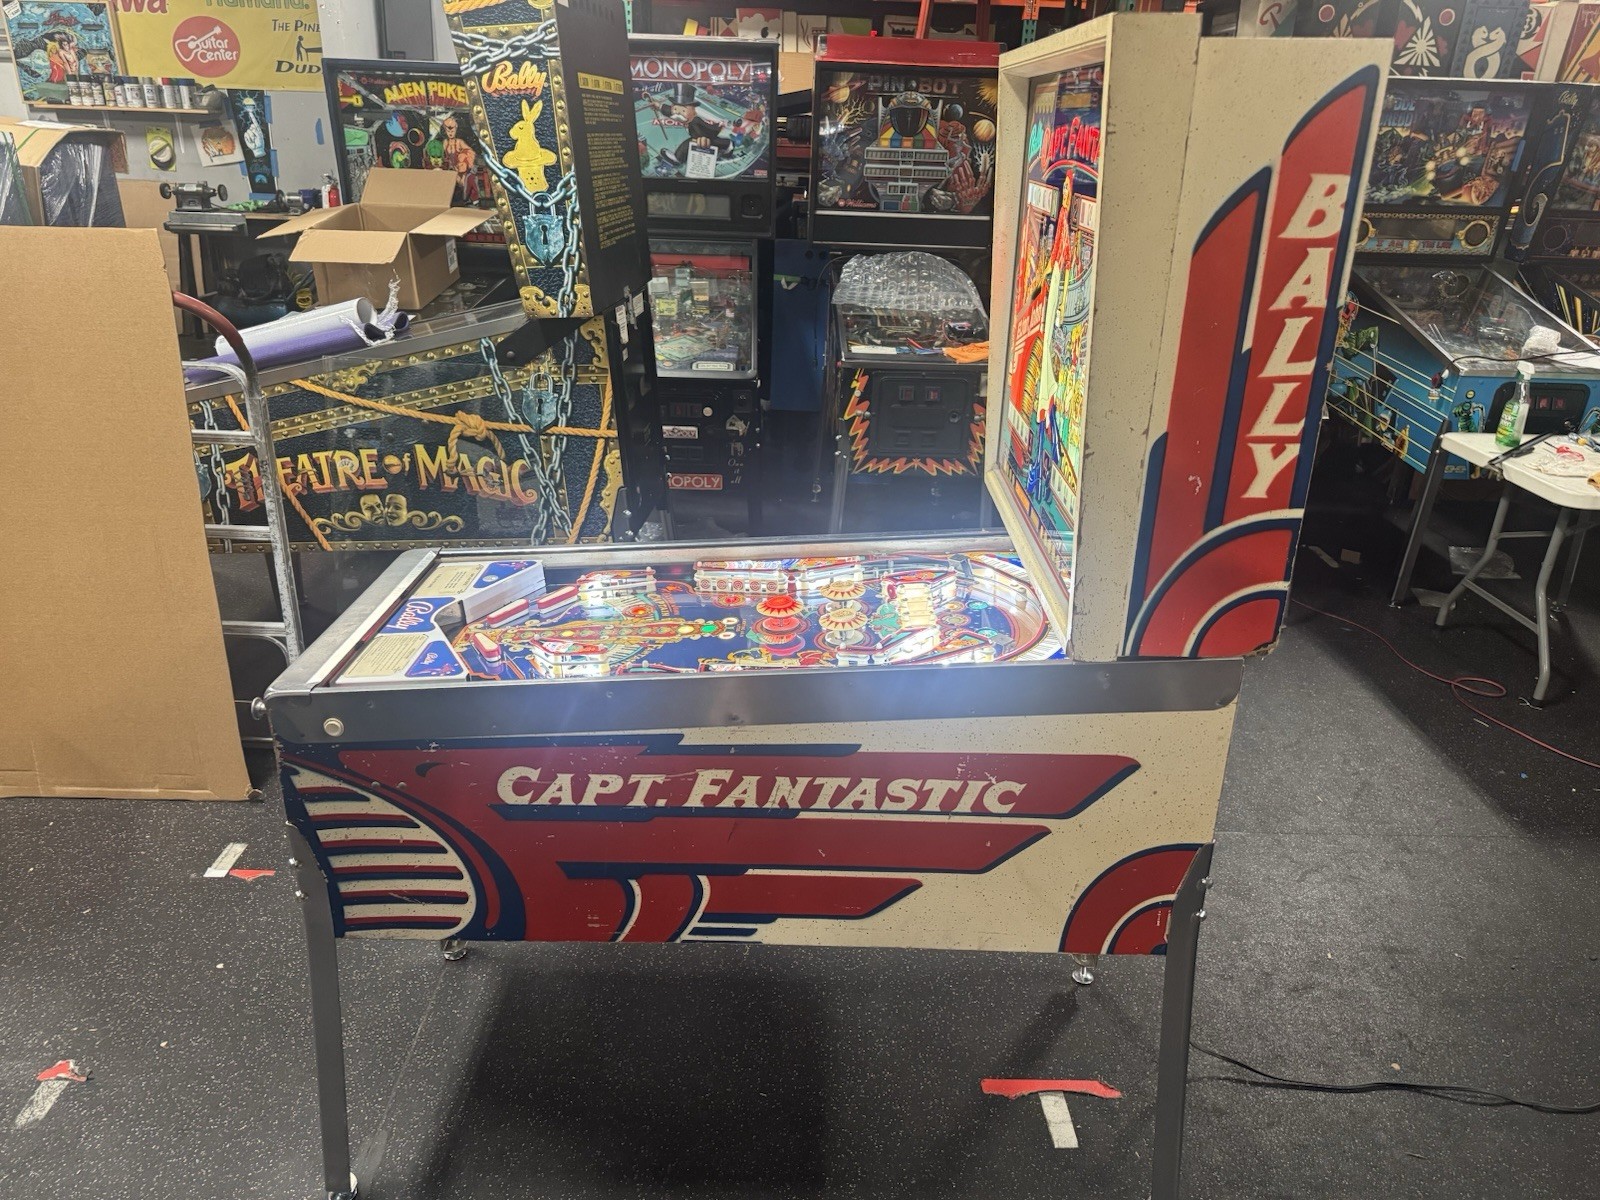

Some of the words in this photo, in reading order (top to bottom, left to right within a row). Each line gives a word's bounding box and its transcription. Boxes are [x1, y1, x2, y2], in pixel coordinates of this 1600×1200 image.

[198, 49, 237, 63] Center
[275, 60, 323, 74] DUD
[384, 81, 426, 104] ALIEN
[482, 61, 547, 98] Bally
[1240, 173, 1351, 499] BALLY
[414, 443, 538, 507] MAGIC
[386, 601, 434, 630] Bally
[497, 766, 668, 806] CAPT.
[682, 768, 1028, 814] FANTASTIC
